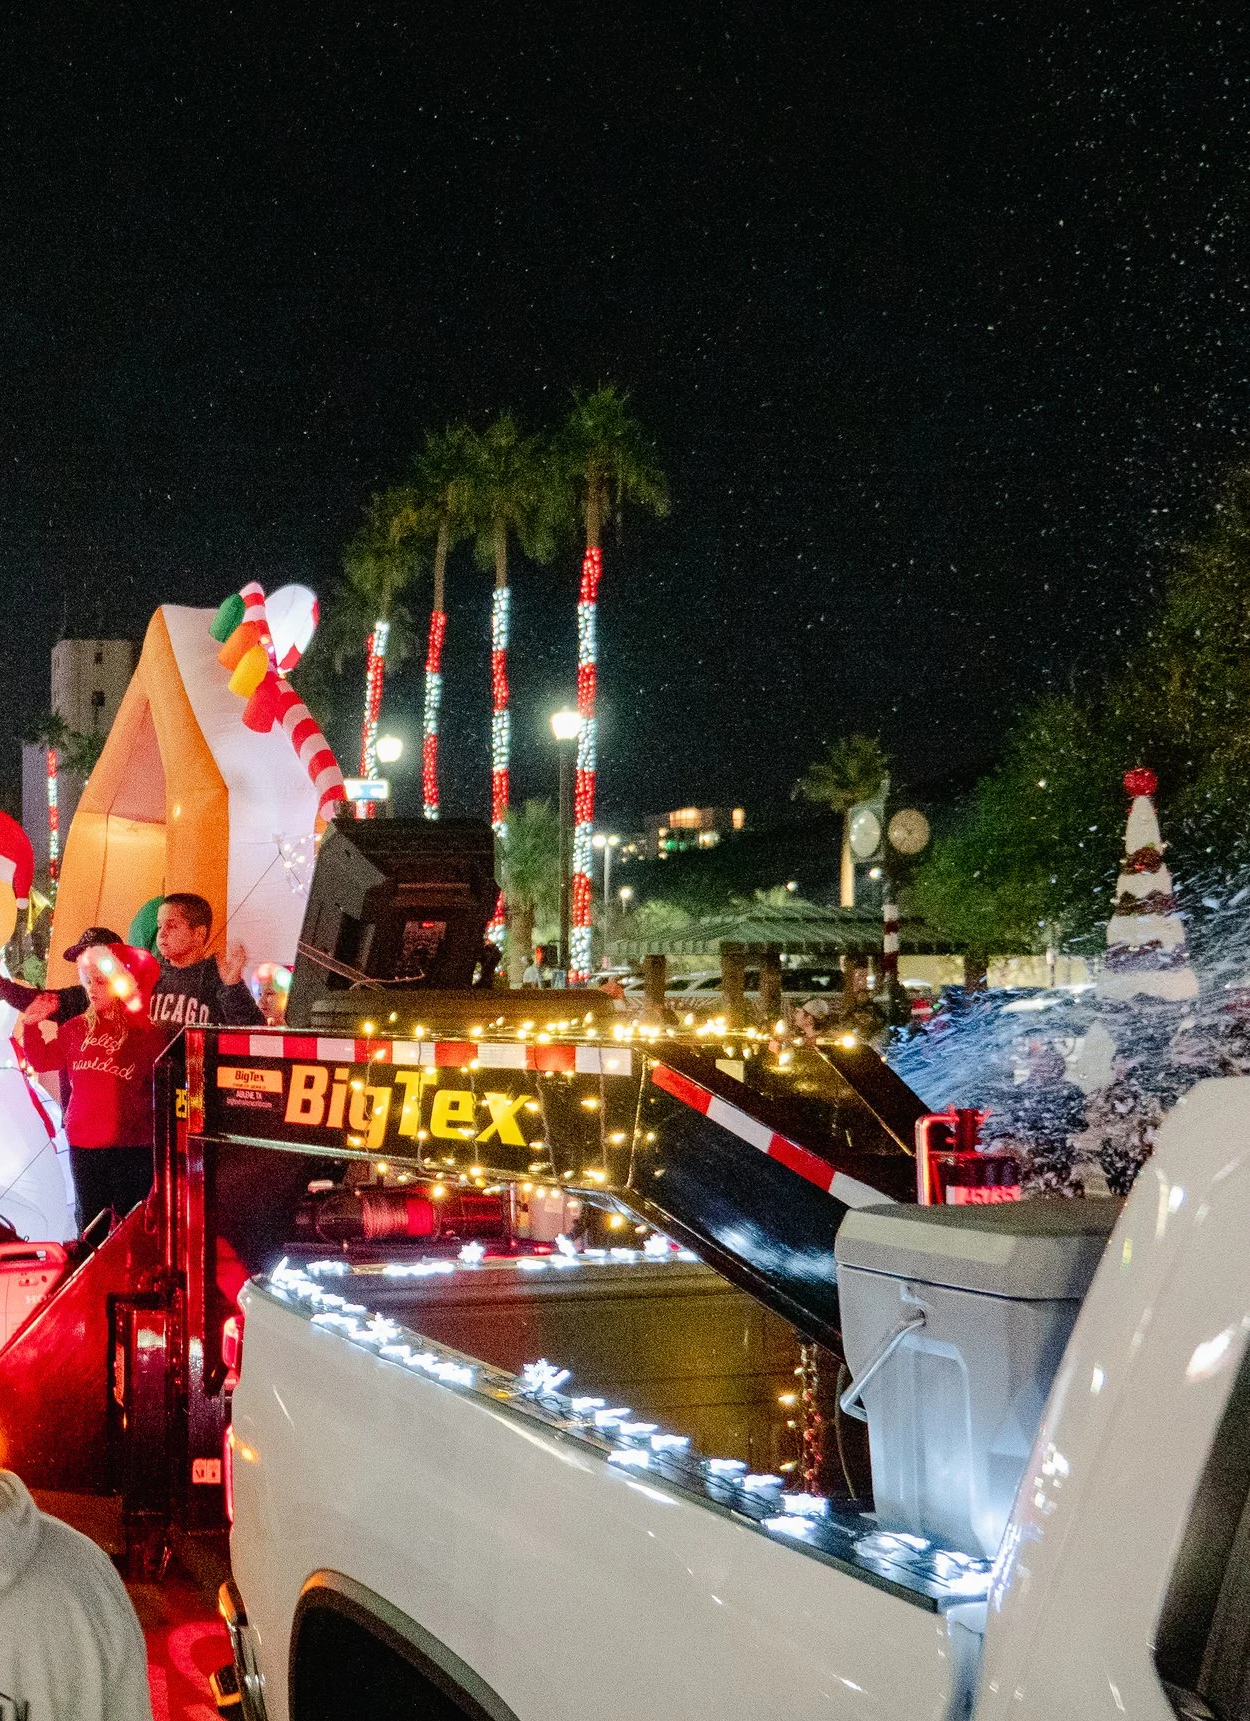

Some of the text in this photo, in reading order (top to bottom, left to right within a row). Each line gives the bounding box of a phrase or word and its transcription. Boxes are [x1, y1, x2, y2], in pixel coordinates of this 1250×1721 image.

[80, 1032, 121, 1055] feliz
[72, 1056, 136, 1080] navidad
[234, 1069, 265, 1083] BigTex
[283, 1064, 533, 1150] BigTex
